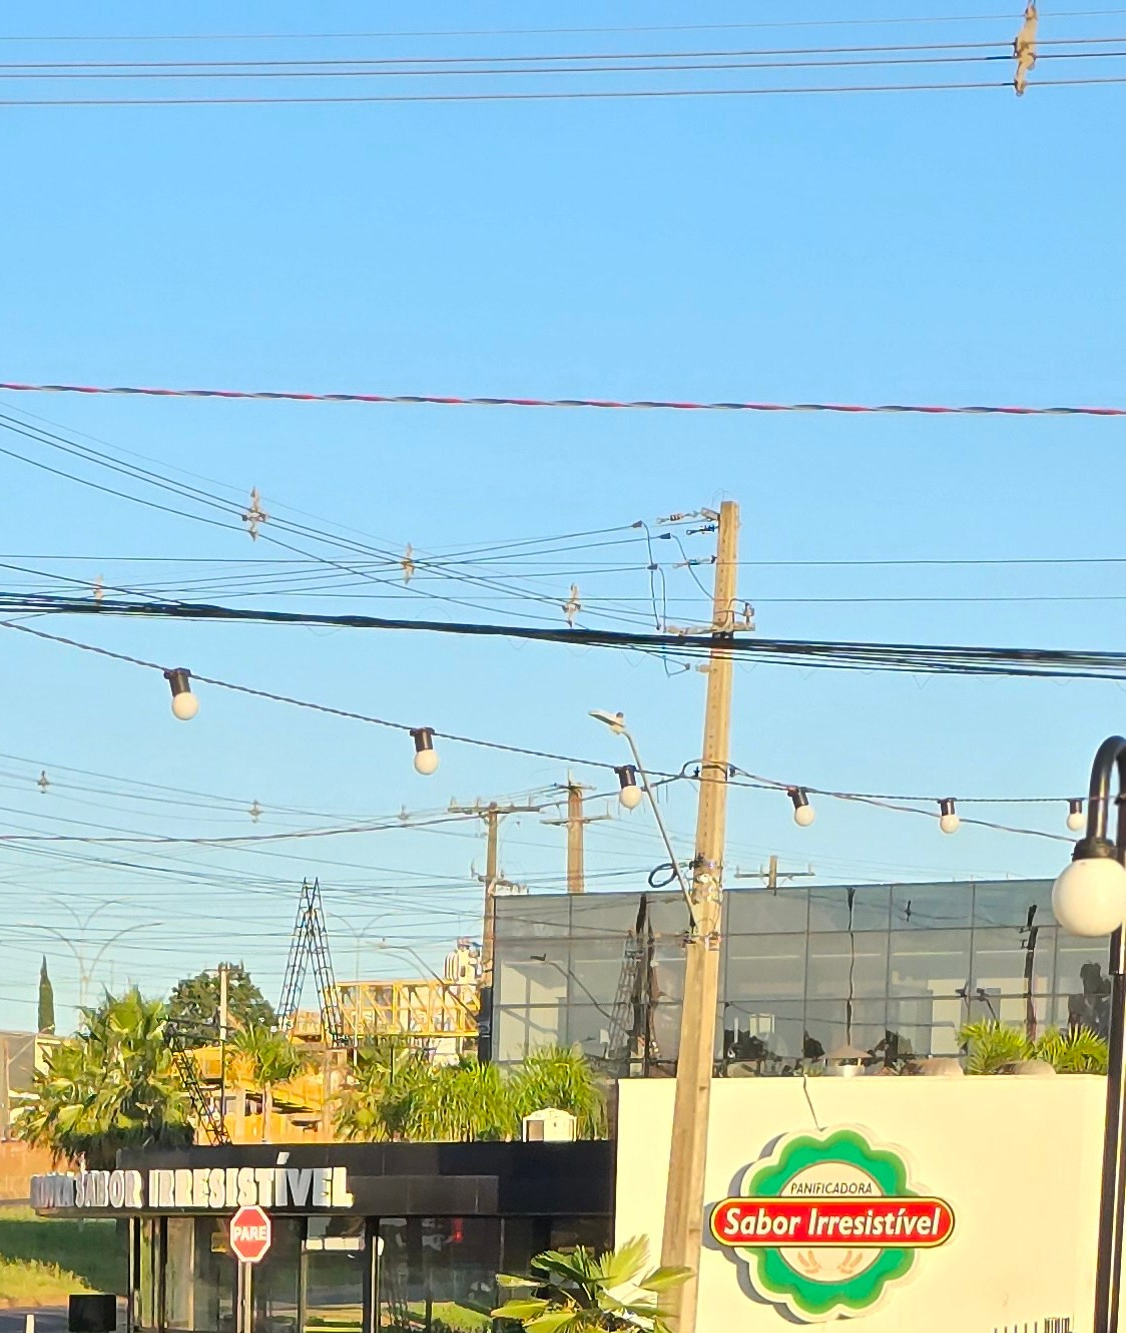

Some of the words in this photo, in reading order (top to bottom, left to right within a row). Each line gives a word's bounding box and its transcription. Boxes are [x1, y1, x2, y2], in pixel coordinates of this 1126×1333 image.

[76, 1170, 143, 1209] SABOR
[149, 1152, 354, 1208] IRRESISTÍVEL
[790, 1182, 873, 1195] PANIFICADORA
[723, 1207, 802, 1235] Sabor
[808, 1207, 942, 1235] Irresistível
[234, 1225, 267, 1242] PARE
